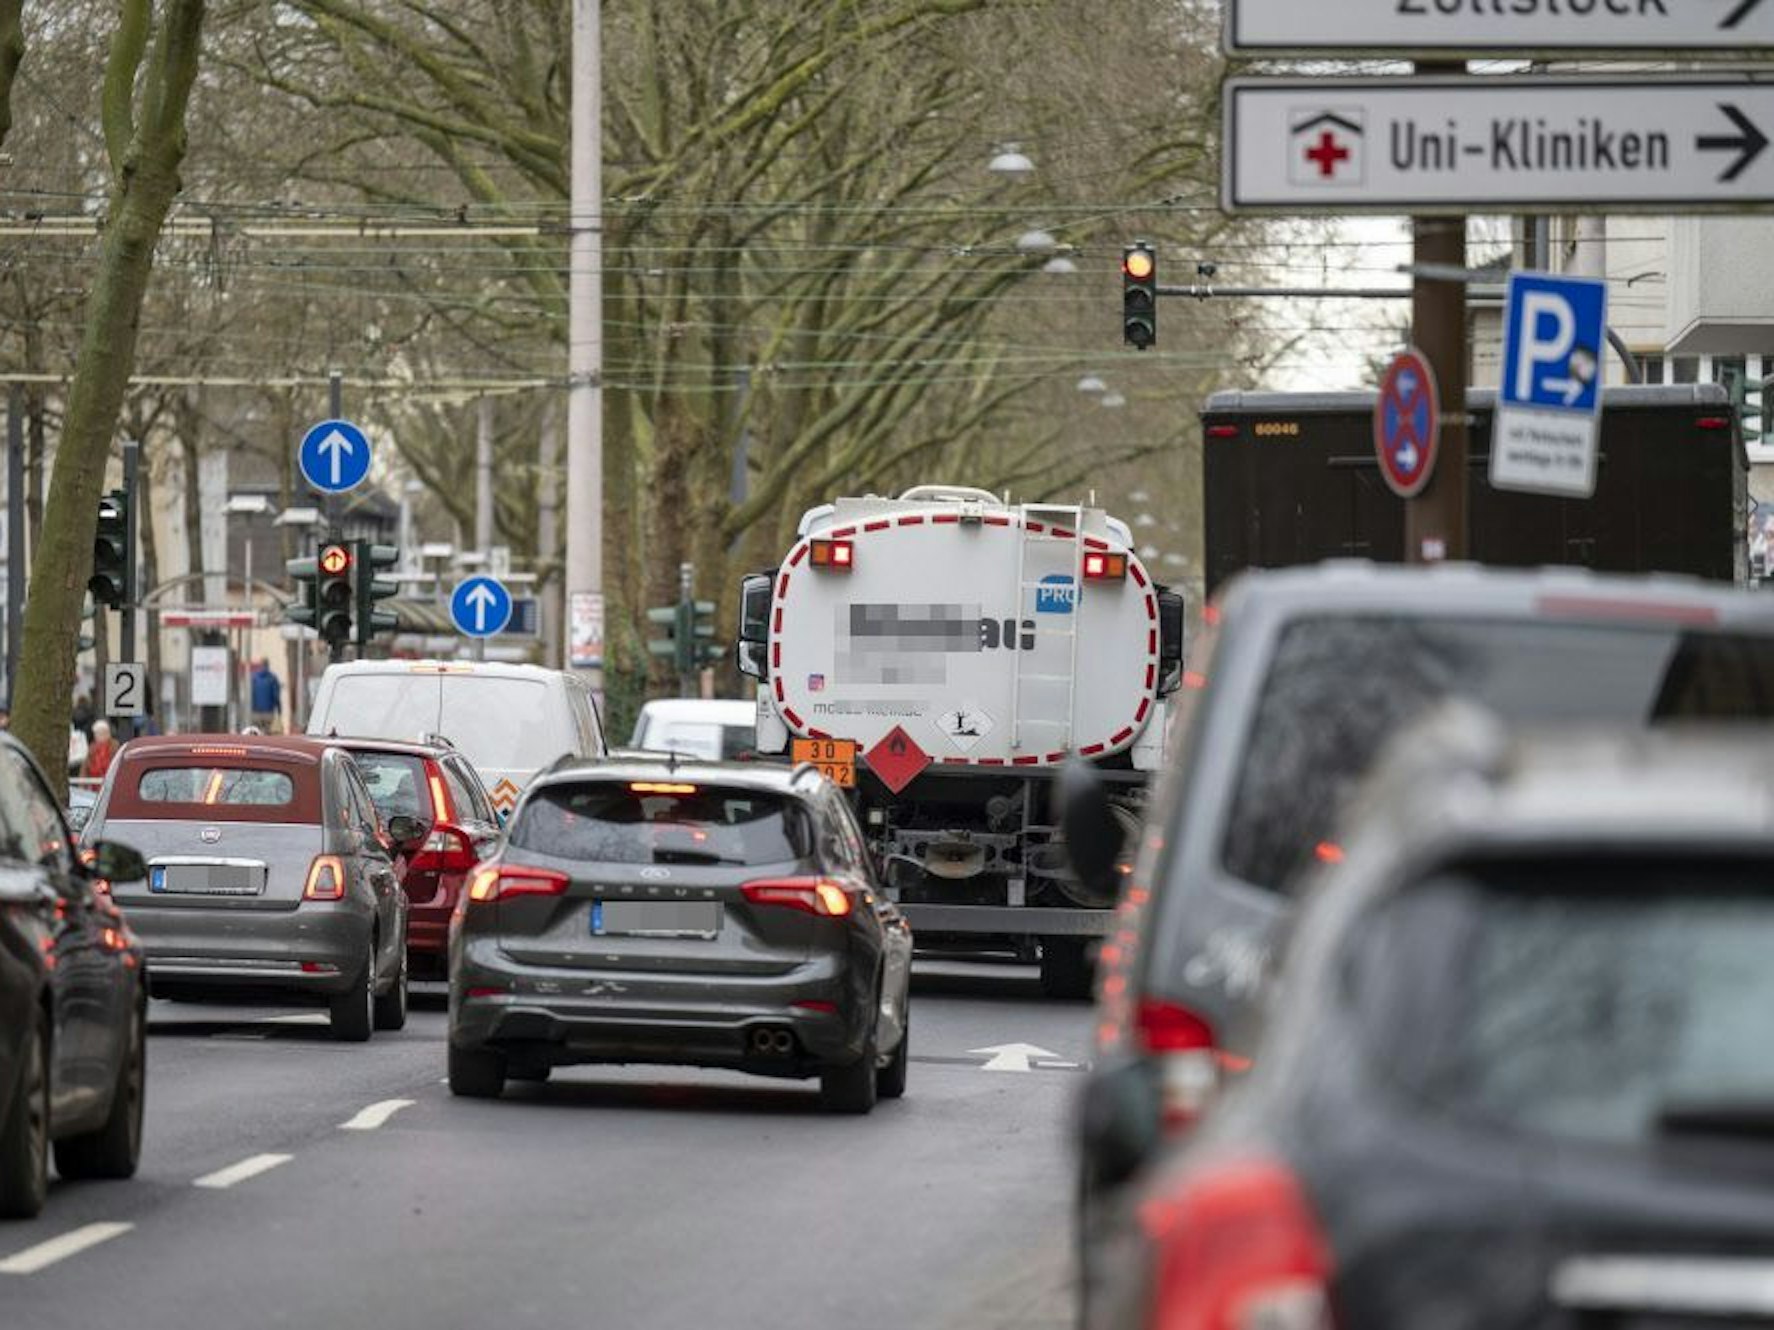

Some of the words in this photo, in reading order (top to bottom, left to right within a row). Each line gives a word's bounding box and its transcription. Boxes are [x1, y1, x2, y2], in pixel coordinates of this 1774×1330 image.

[1389, 118, 1669, 171] Uni-Kliniken
[1515, 290, 1576, 401] P
[114, 671, 134, 709] 2
[810, 742, 835, 759] 30
